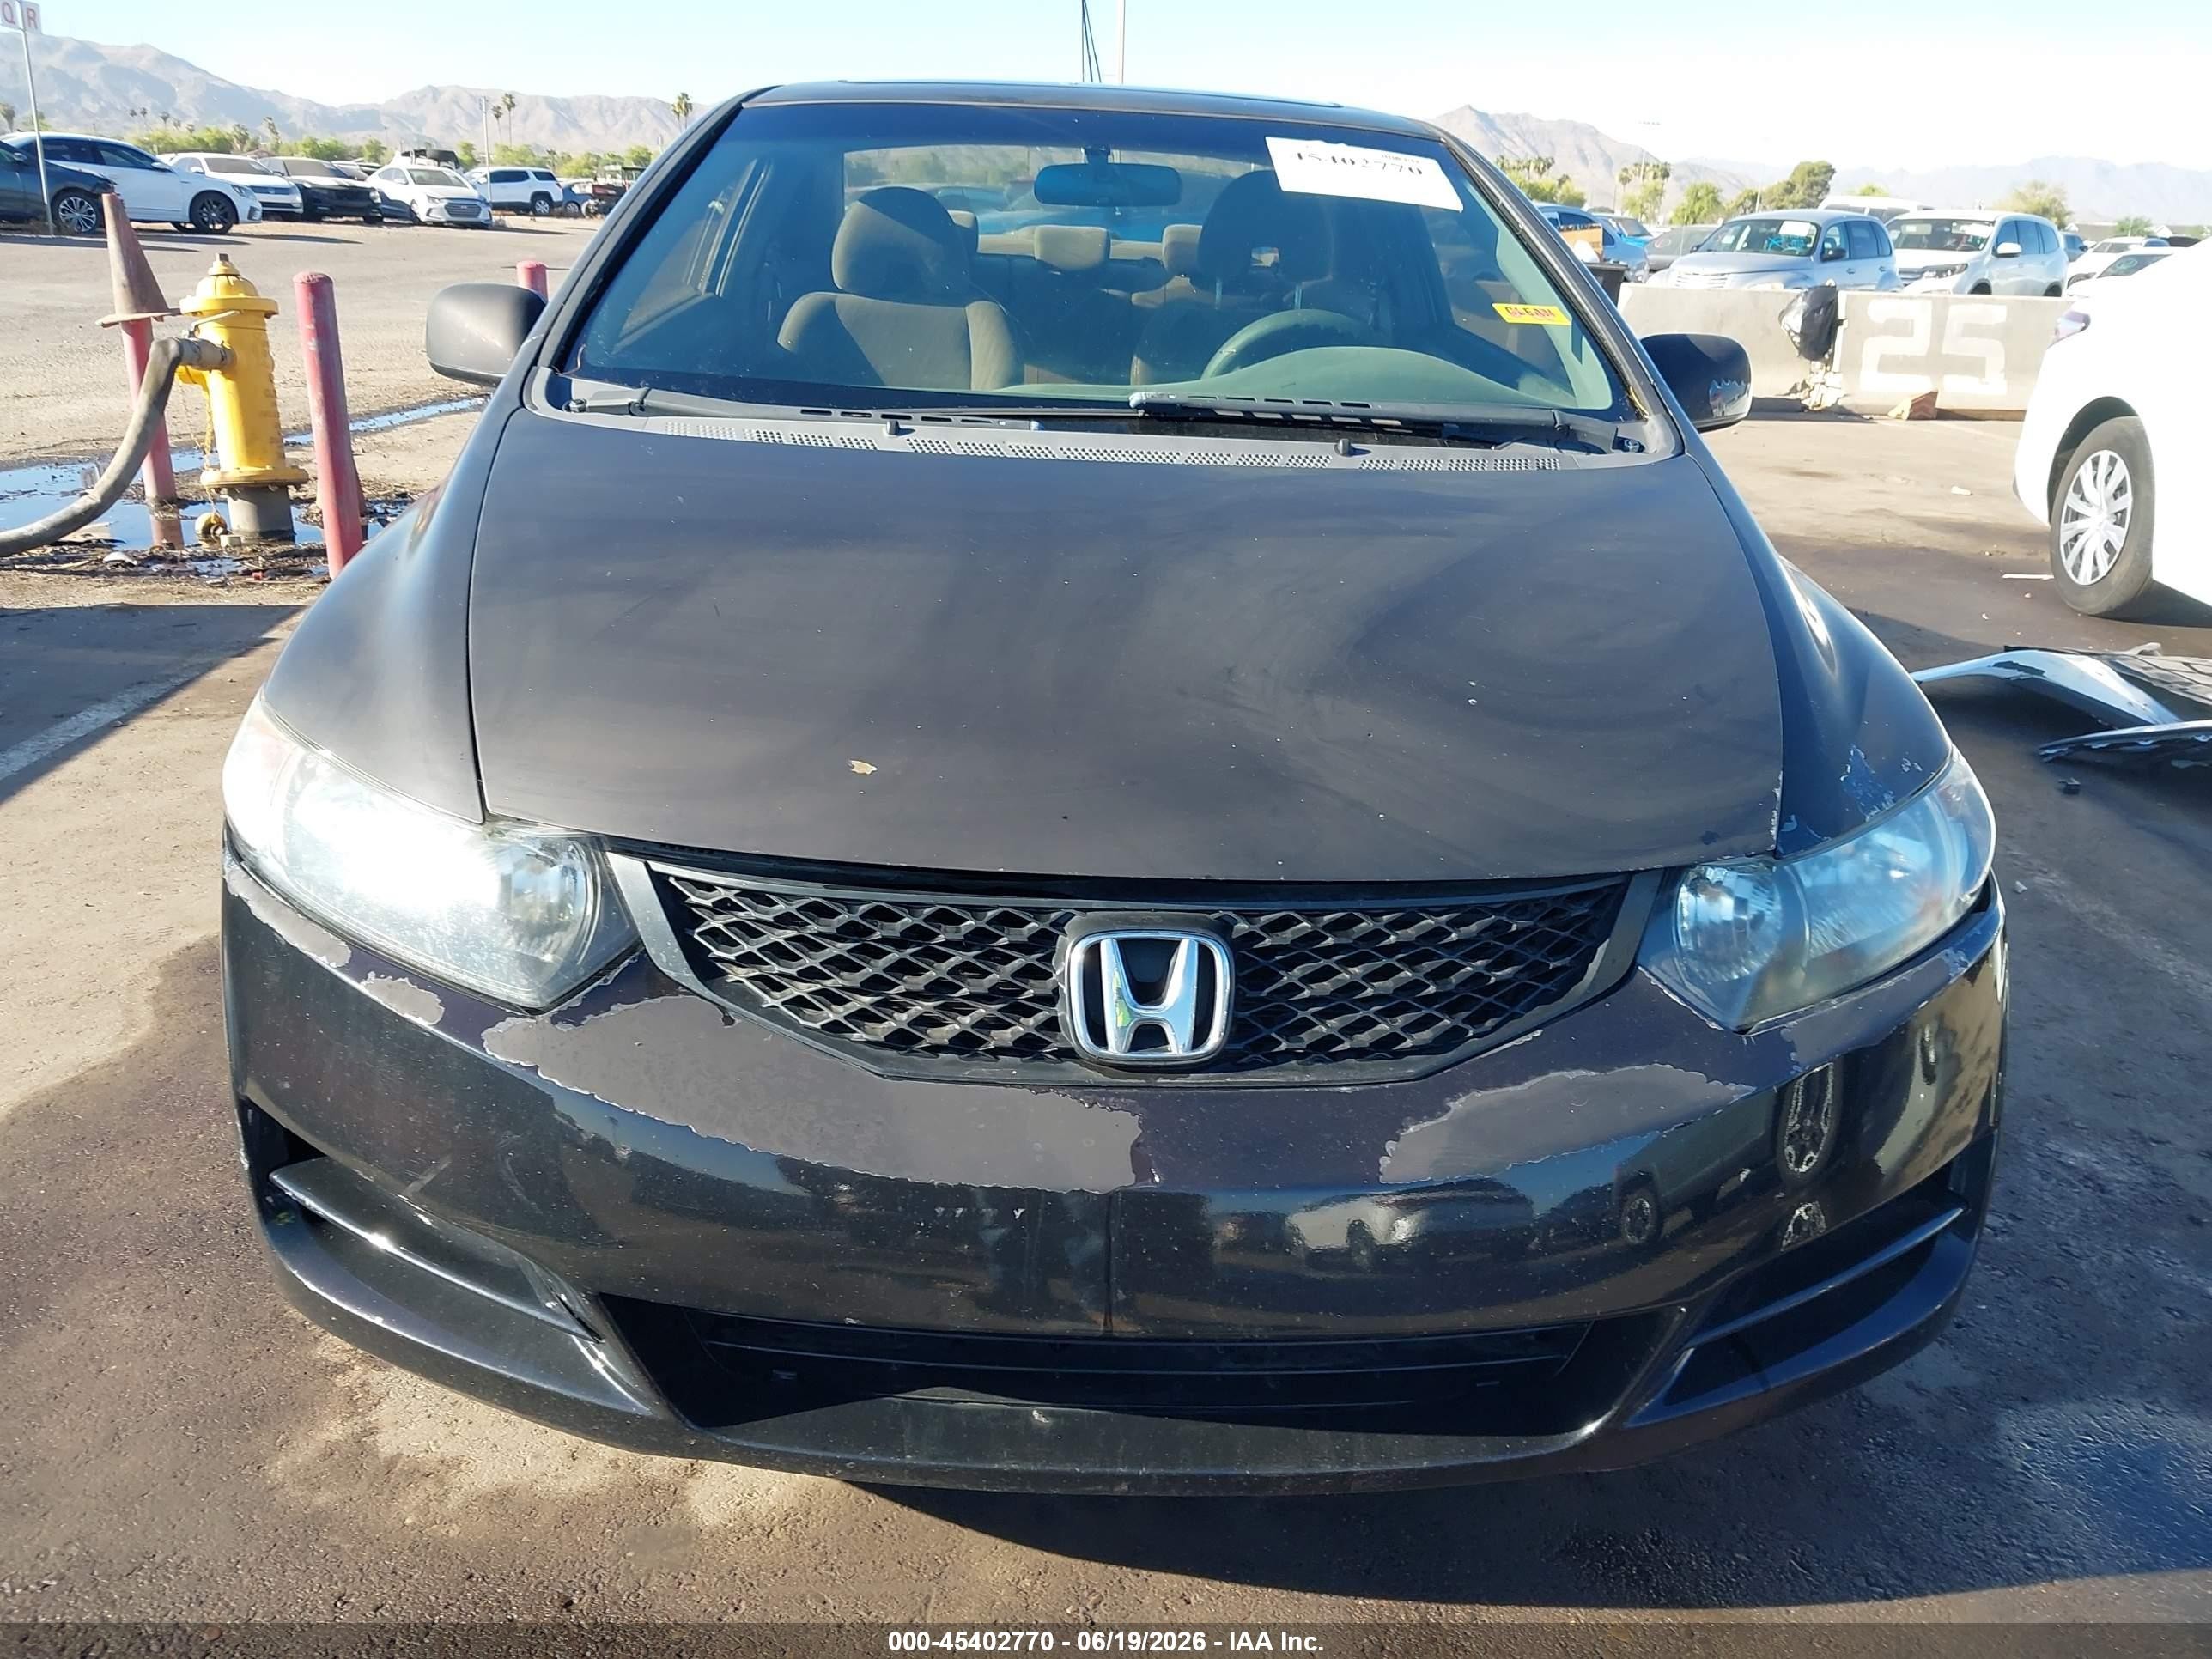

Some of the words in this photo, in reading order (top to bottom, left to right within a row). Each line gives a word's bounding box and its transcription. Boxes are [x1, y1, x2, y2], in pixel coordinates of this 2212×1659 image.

[1, 1, 15, 25] Q
[26, 7, 39, 30] R
[1860, 298, 2008, 395] 25
